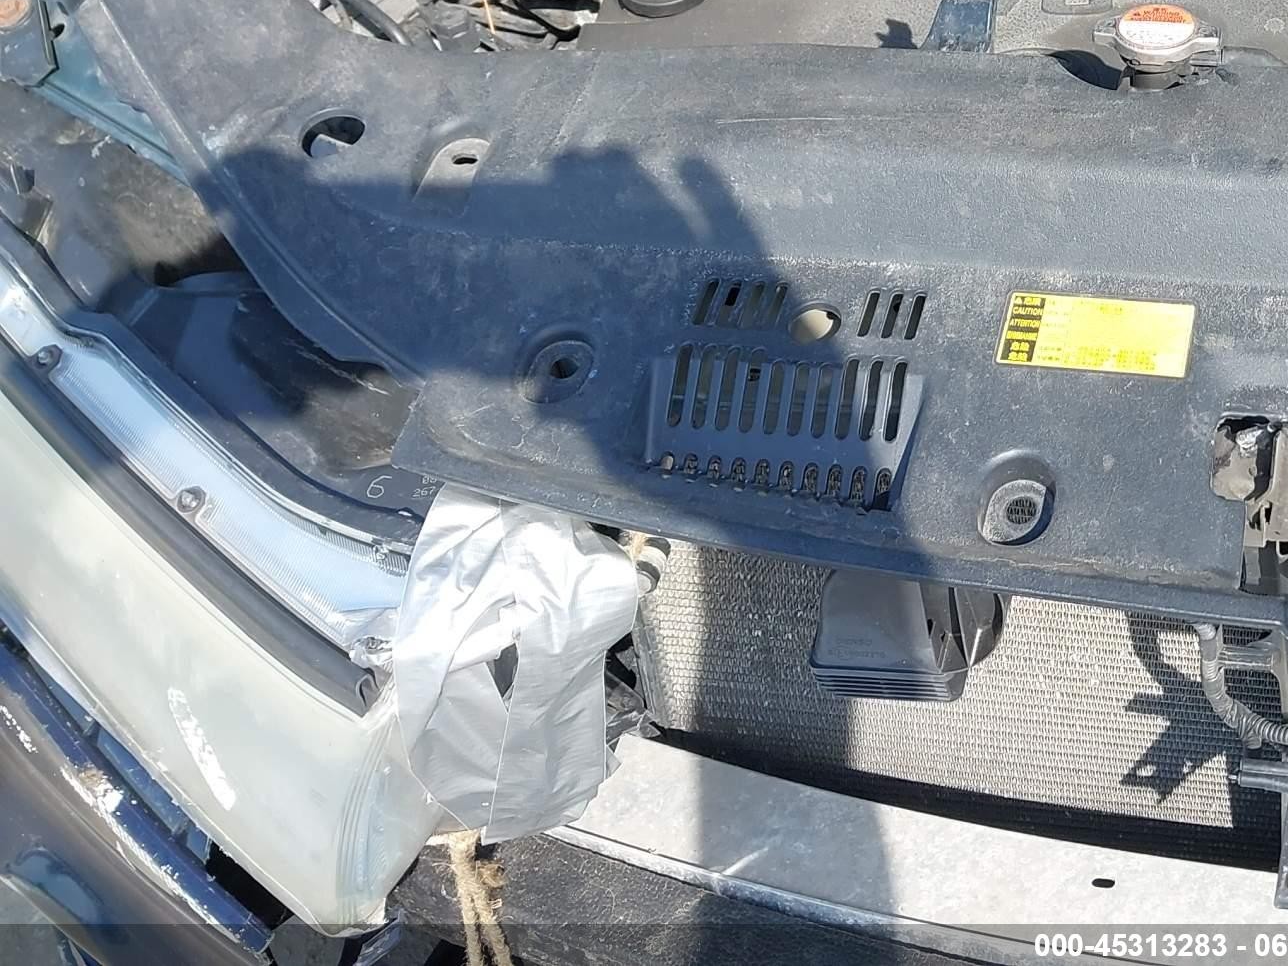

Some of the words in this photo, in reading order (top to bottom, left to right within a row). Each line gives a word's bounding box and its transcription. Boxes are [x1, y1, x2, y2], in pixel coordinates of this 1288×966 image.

[1013, 306, 1044, 316] CAUTION
[1010, 318, 1041, 328] ATTENTION
[366, 475, 392, 499] 6
